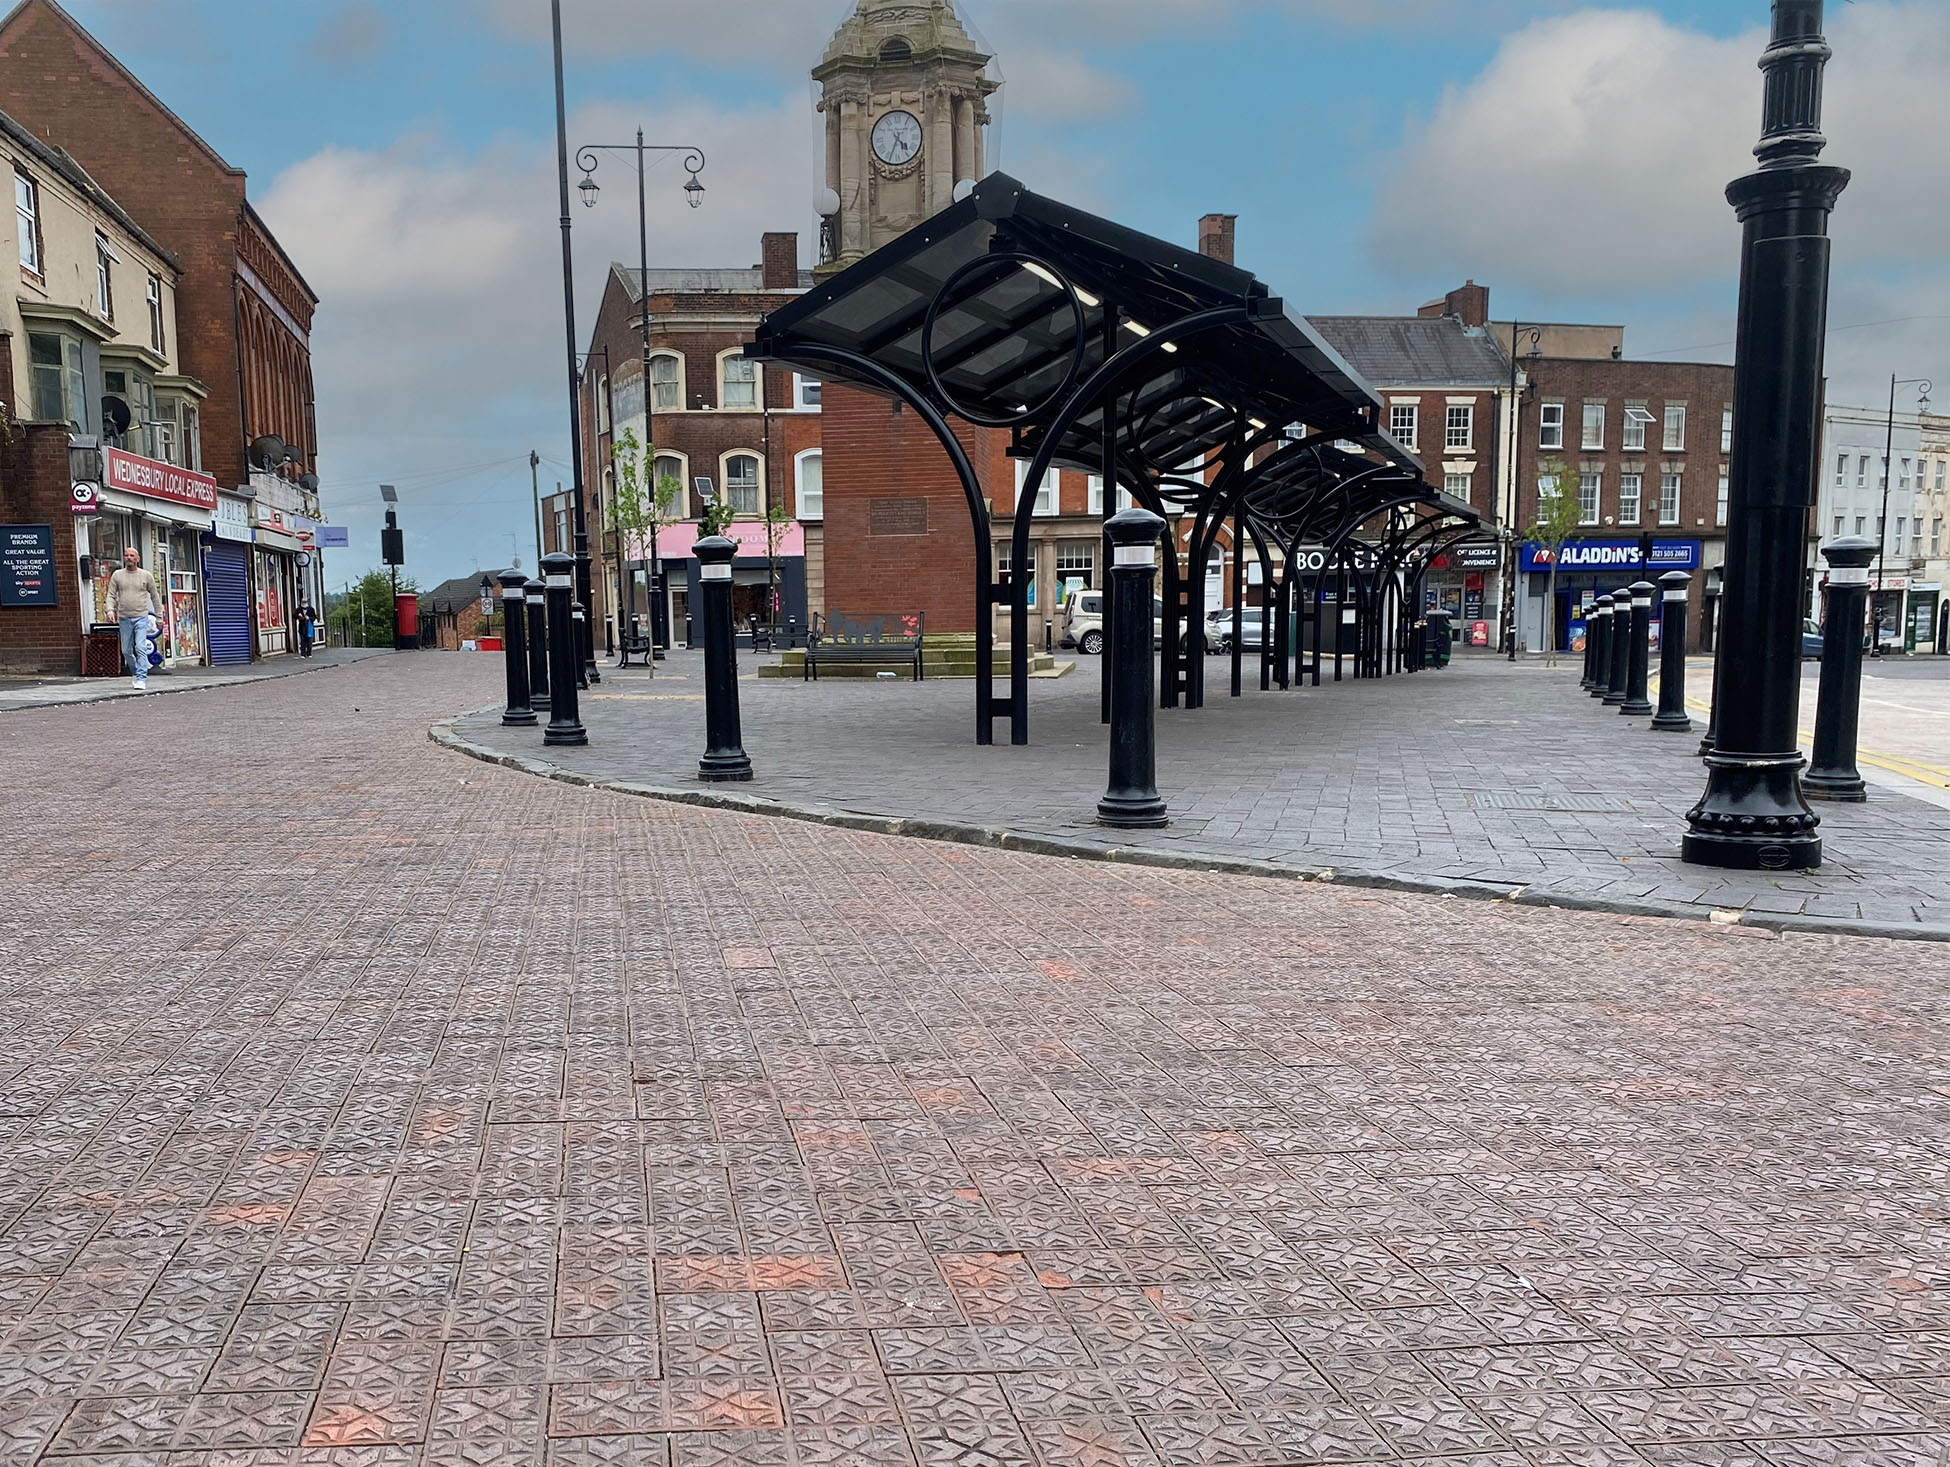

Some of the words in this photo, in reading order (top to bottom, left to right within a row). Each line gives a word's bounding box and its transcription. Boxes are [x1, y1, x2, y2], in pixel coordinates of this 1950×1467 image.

[113, 457, 164, 490] WEDNESBURY
[164, 472, 186, 497] LOCAL
[186, 479, 214, 502] EXPRESS
